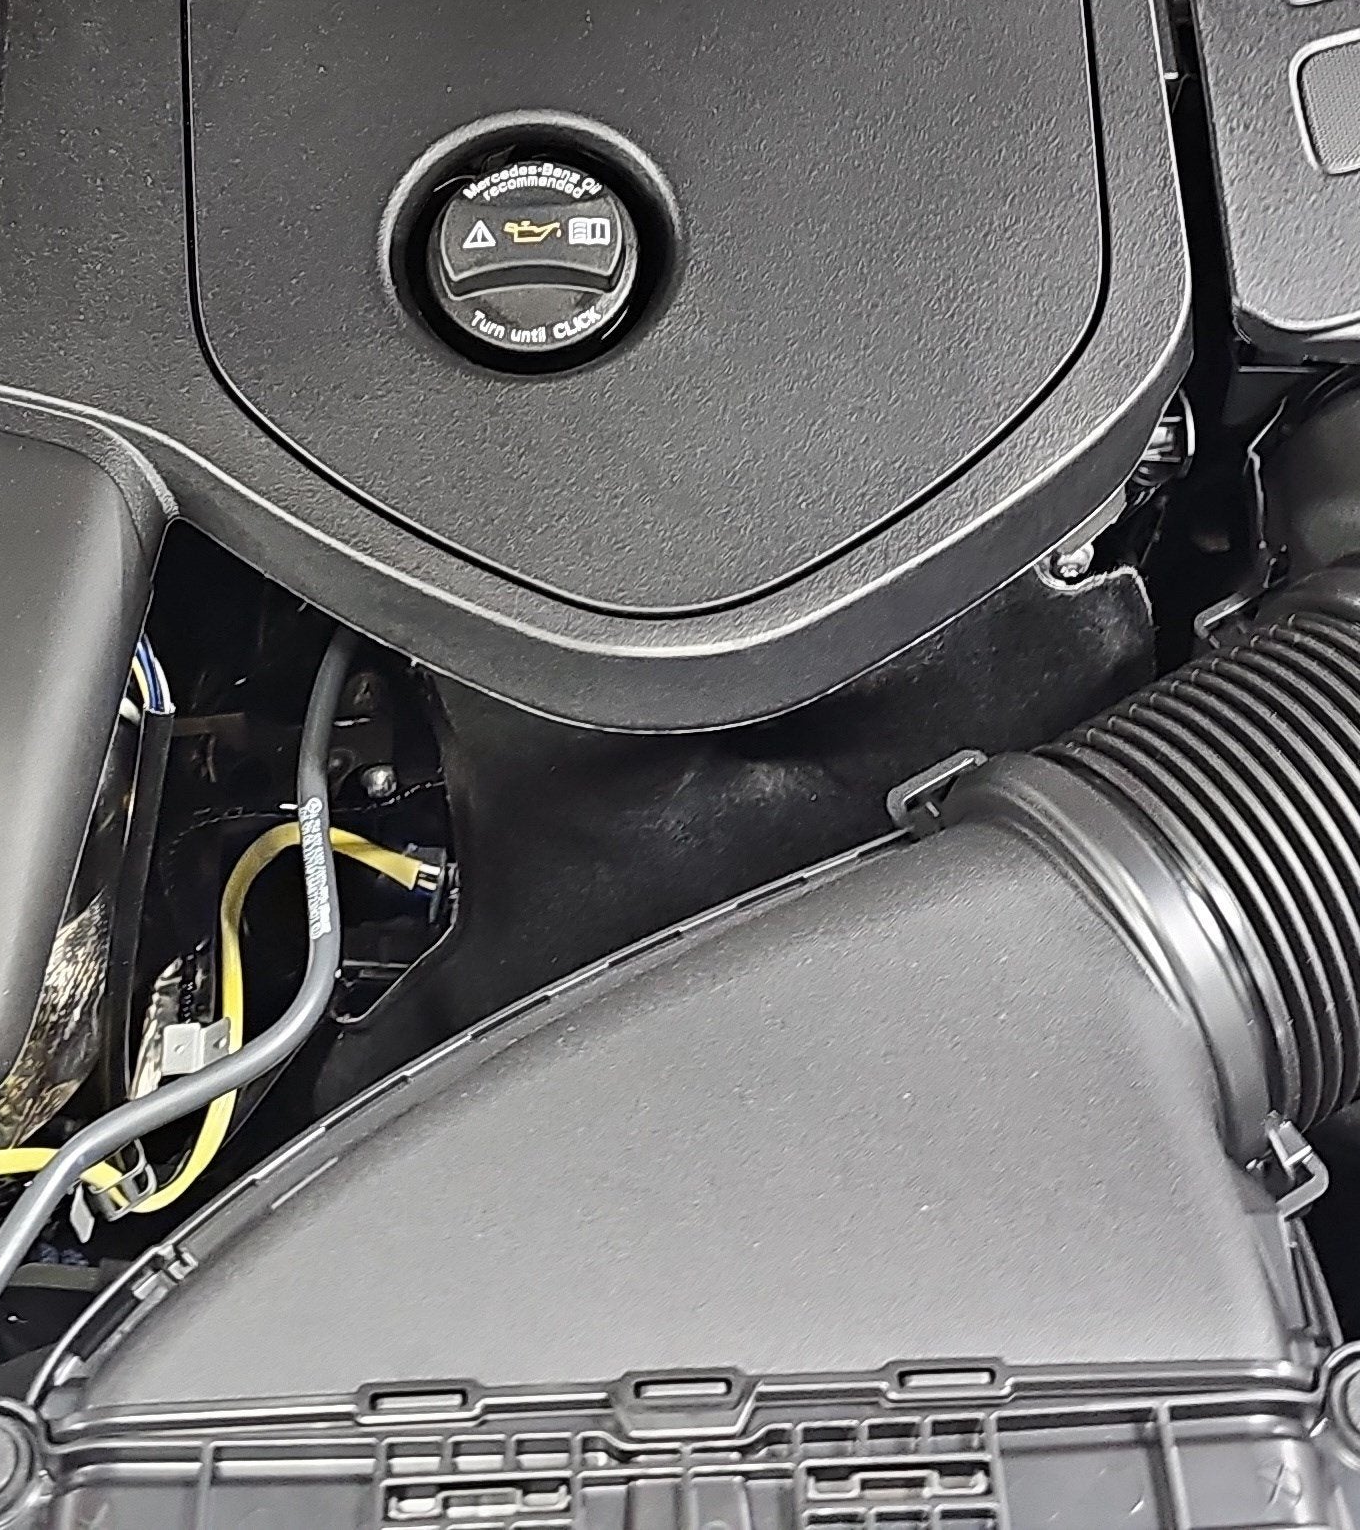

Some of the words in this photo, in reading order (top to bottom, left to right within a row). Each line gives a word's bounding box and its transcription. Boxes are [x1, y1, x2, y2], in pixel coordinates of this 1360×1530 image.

[482, 175, 583, 201] recommended
[471, 310, 506, 339] Turn
[510, 326, 547, 343] until
[552, 305, 602, 339] CLICK
